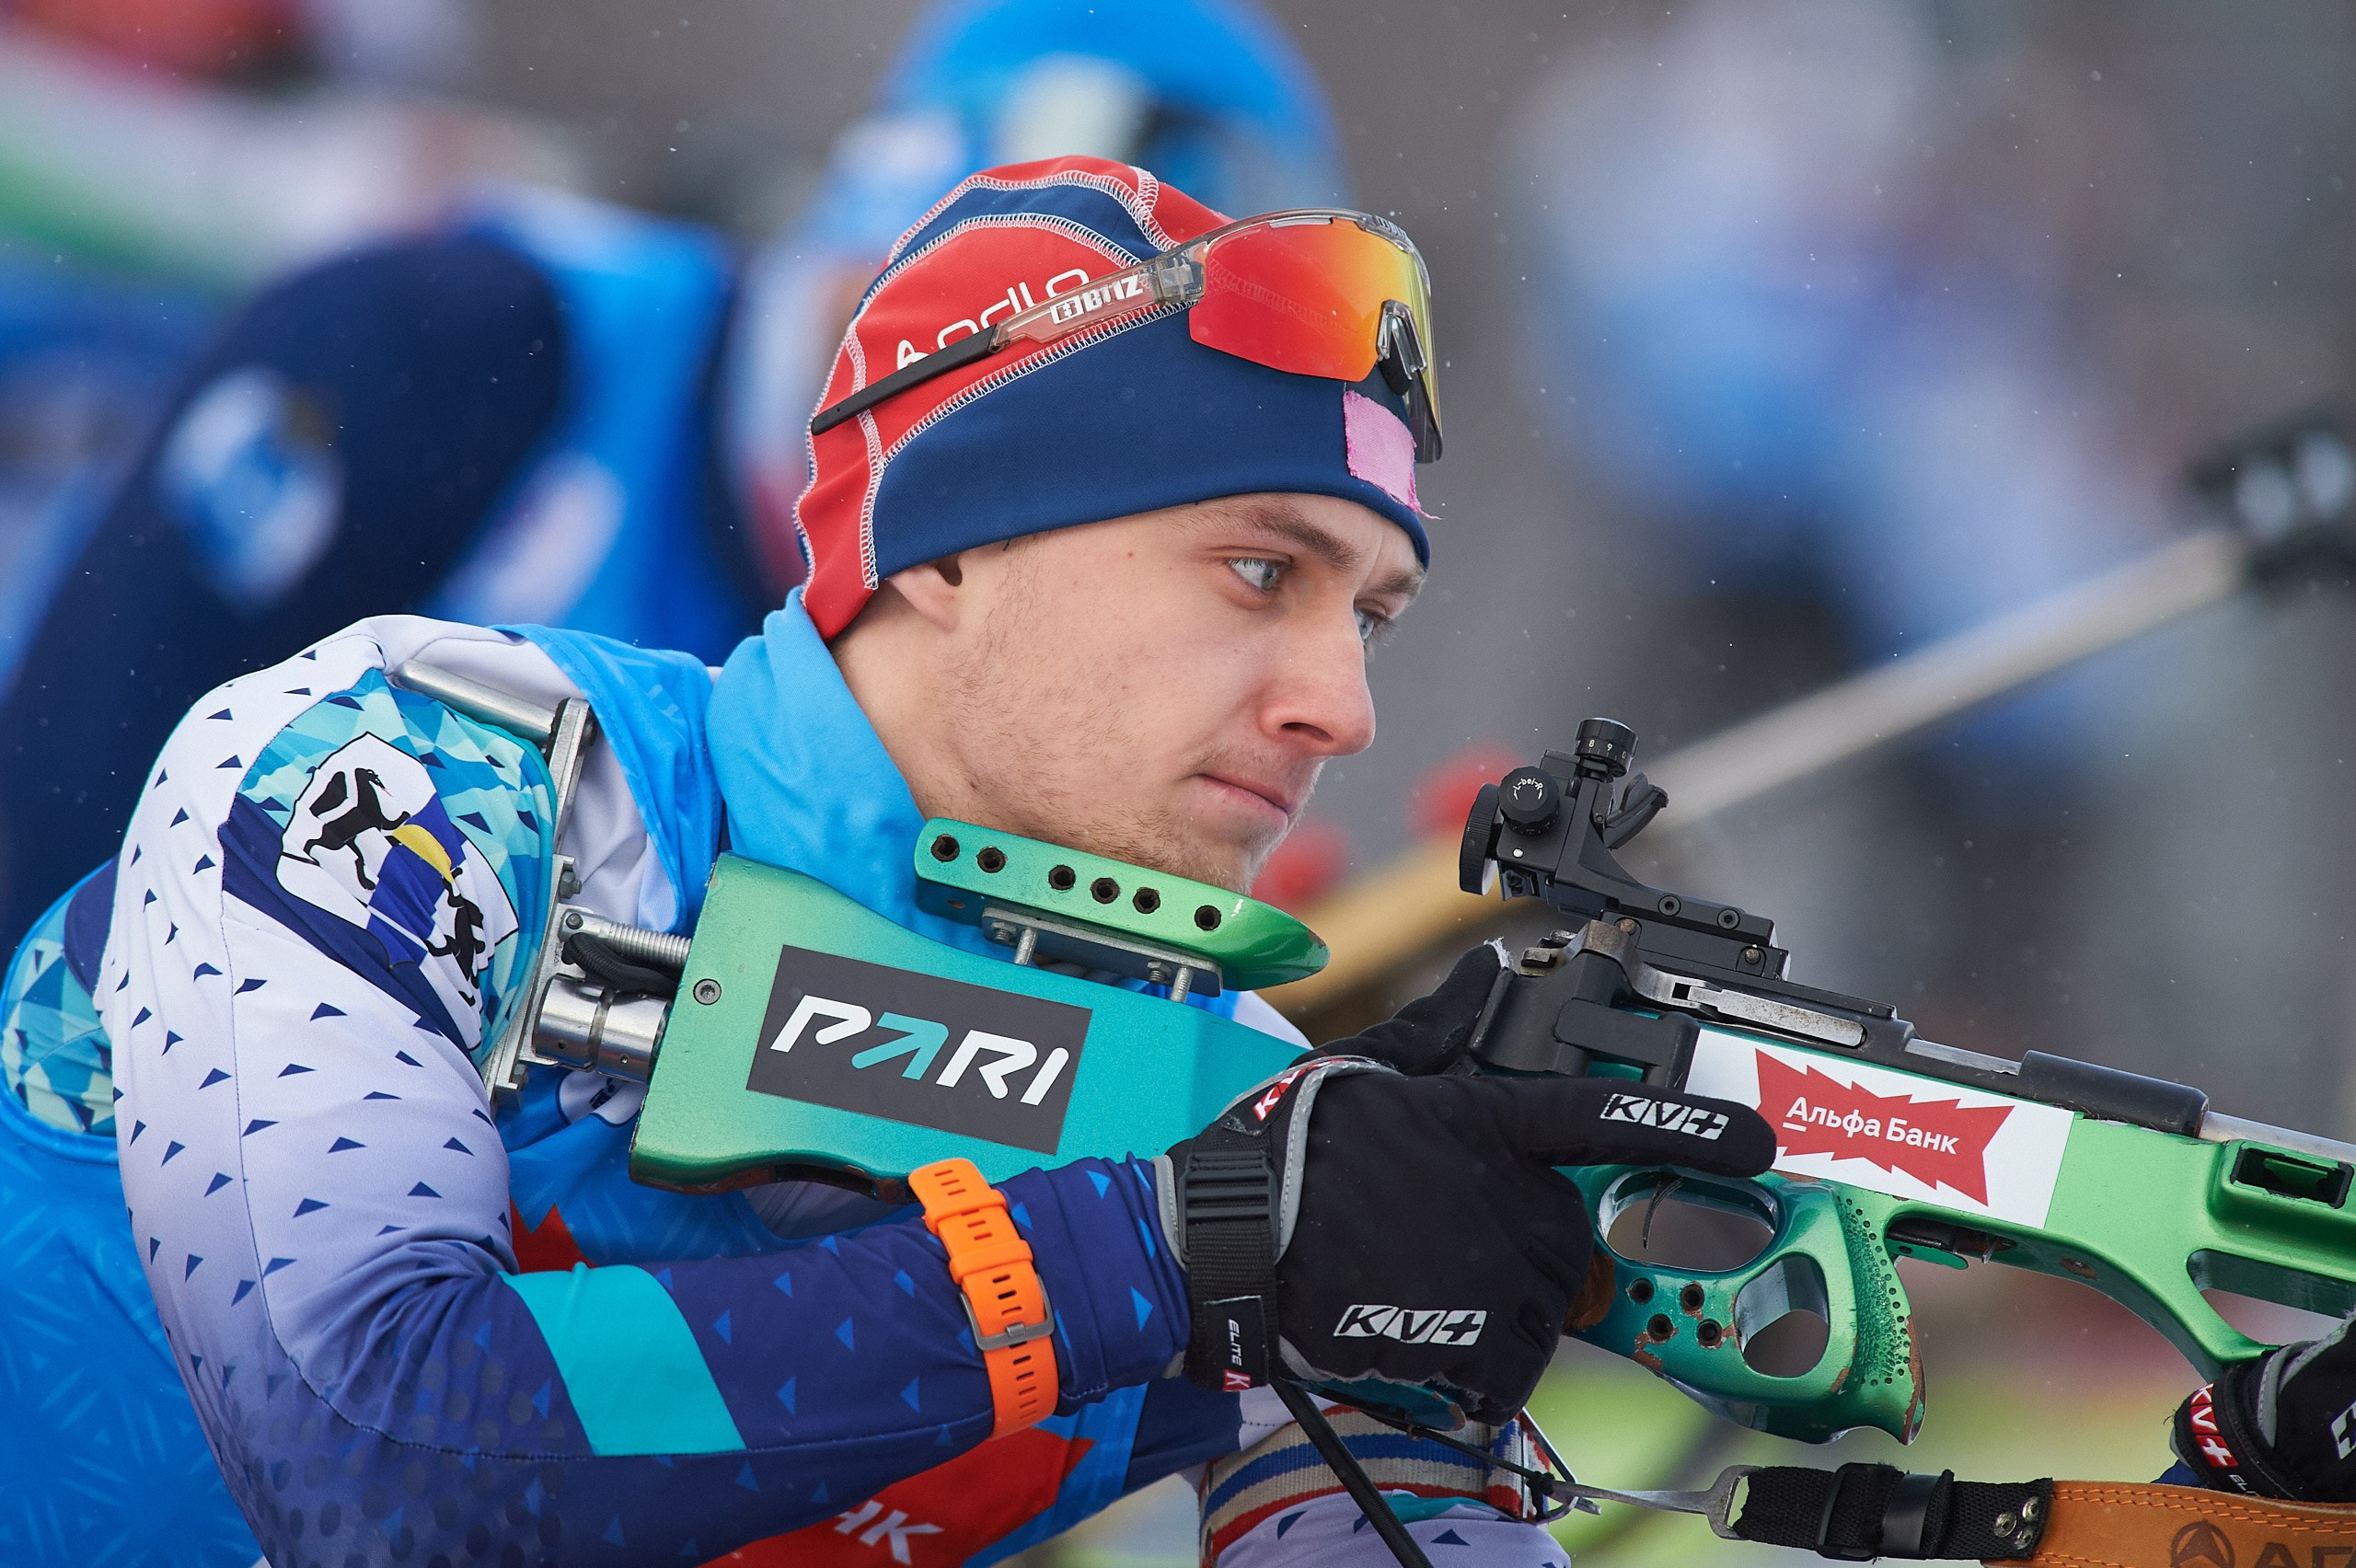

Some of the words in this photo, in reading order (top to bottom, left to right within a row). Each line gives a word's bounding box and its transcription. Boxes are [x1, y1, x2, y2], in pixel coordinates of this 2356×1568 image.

[1588, 739, 1595, 748] 8
[1607, 744, 1613, 752] 9
[770, 994, 1069, 1106] PARI
[1785, 1096, 1881, 1138] Альфа
[1886, 1117, 1959, 1155] Банк
[1229, 1319, 1242, 1366] ELITE
